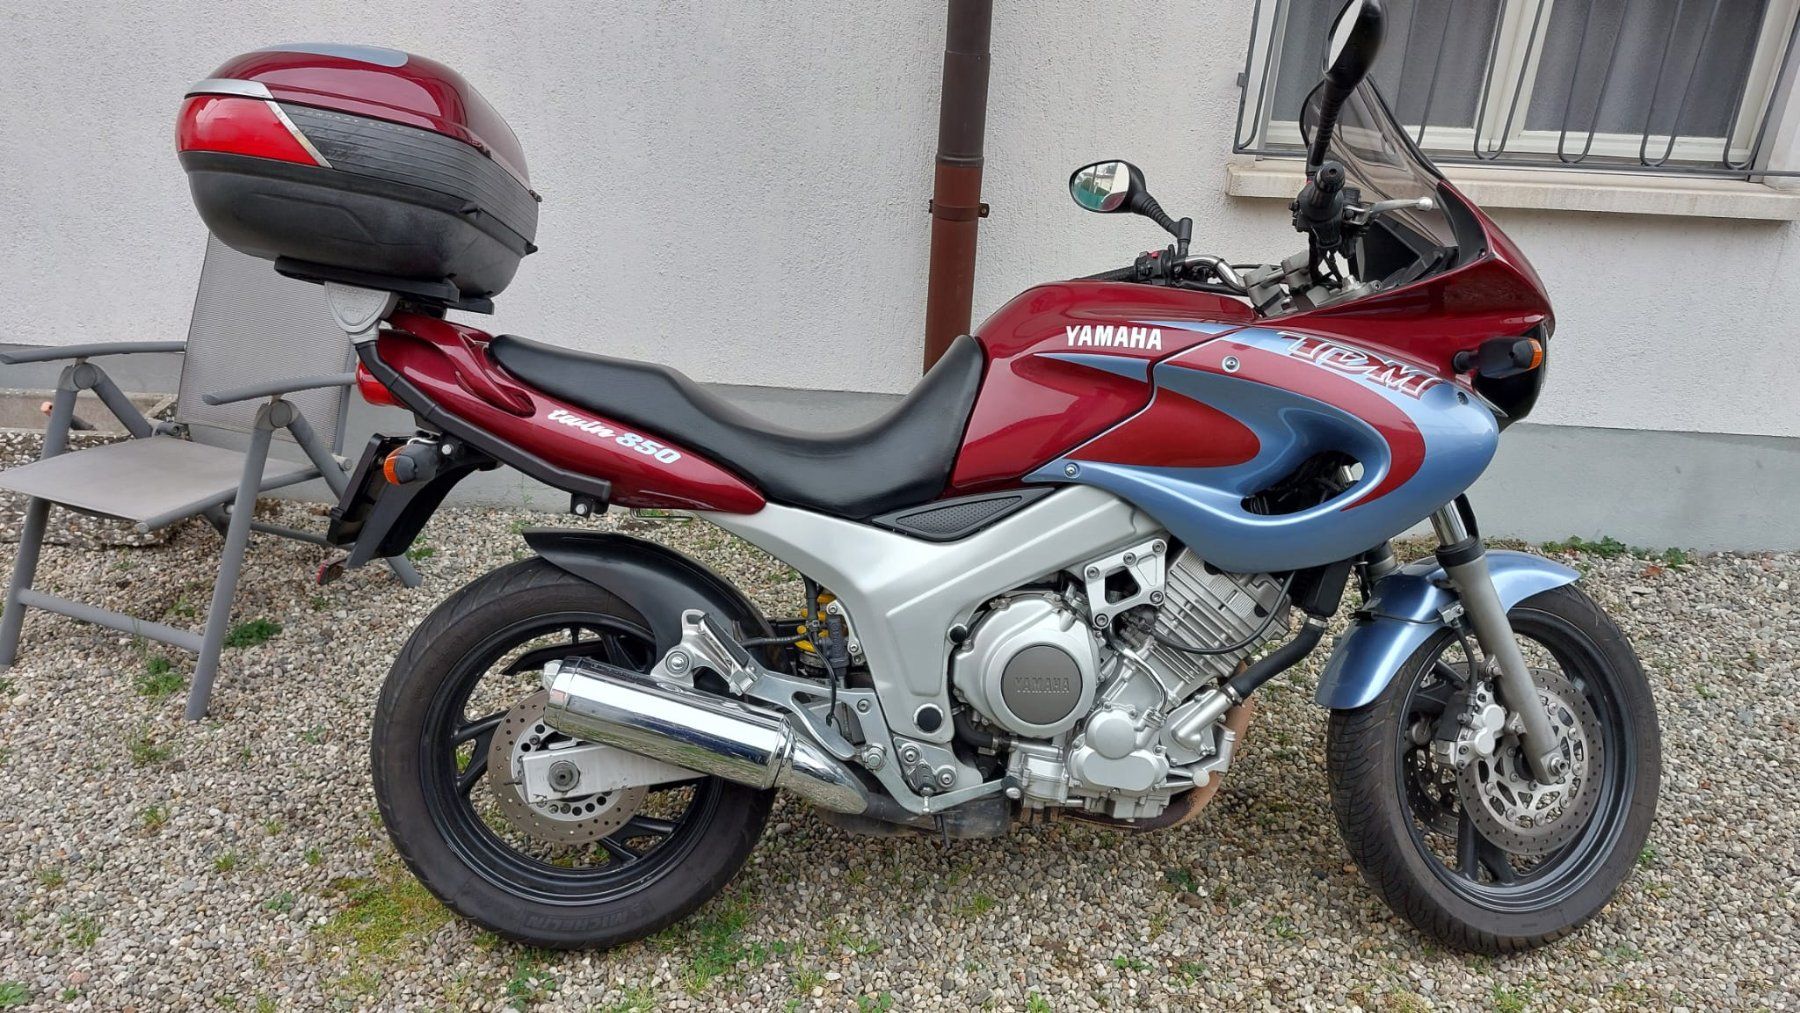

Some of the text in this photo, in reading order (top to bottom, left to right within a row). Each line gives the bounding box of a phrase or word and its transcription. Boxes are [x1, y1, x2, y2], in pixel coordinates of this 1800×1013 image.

[1065, 325, 1162, 350] YAMAHA
[1276, 331, 1443, 400] TDM
[547, 409, 682, 464] twin 850
[1015, 676, 1070, 694] YAMAHA
[524, 909, 629, 932] MICHELIN
